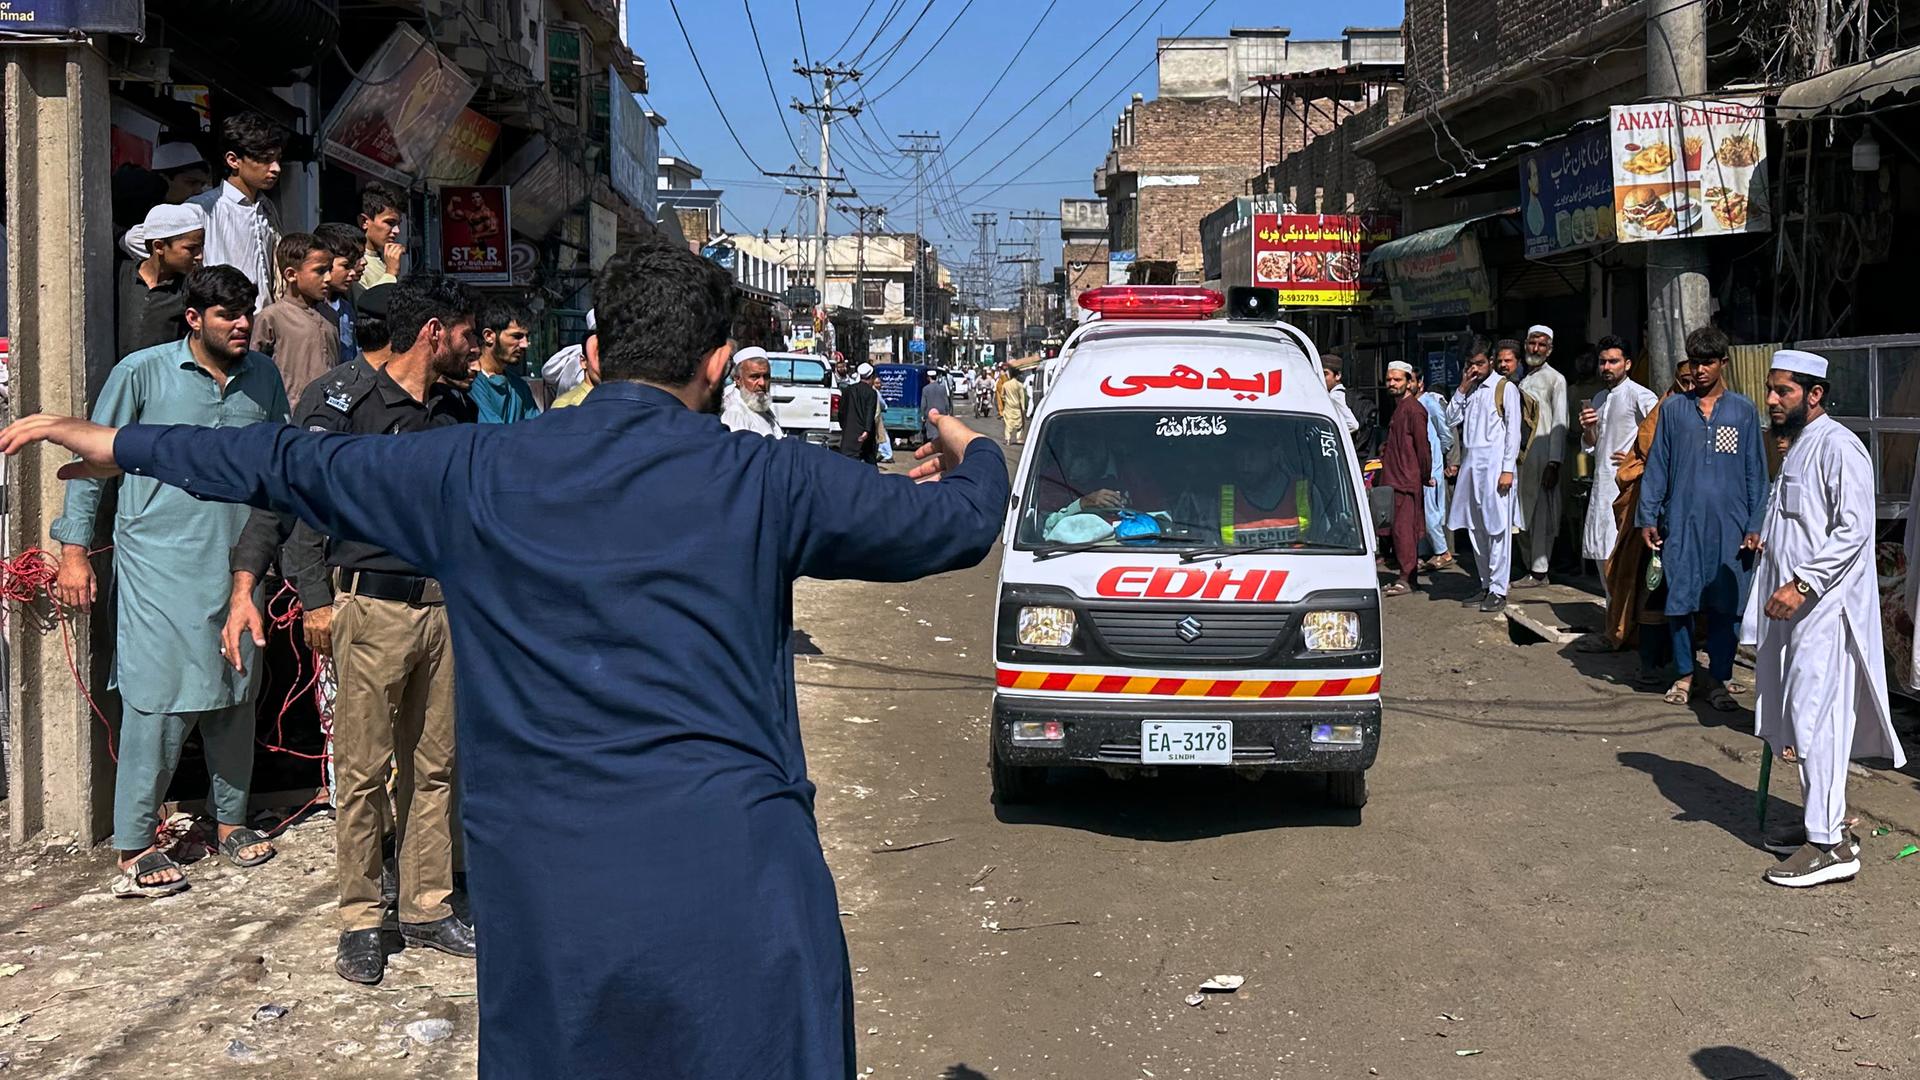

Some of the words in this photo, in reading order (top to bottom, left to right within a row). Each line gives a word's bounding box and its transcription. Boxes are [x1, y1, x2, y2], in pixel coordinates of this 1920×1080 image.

[1616, 110, 1674, 131] ANAYA
[1100, 364, 1282, 402] ایدھی
[1096, 566, 1289, 602] EDHI
[1148, 732, 1227, 752] EA-3178
